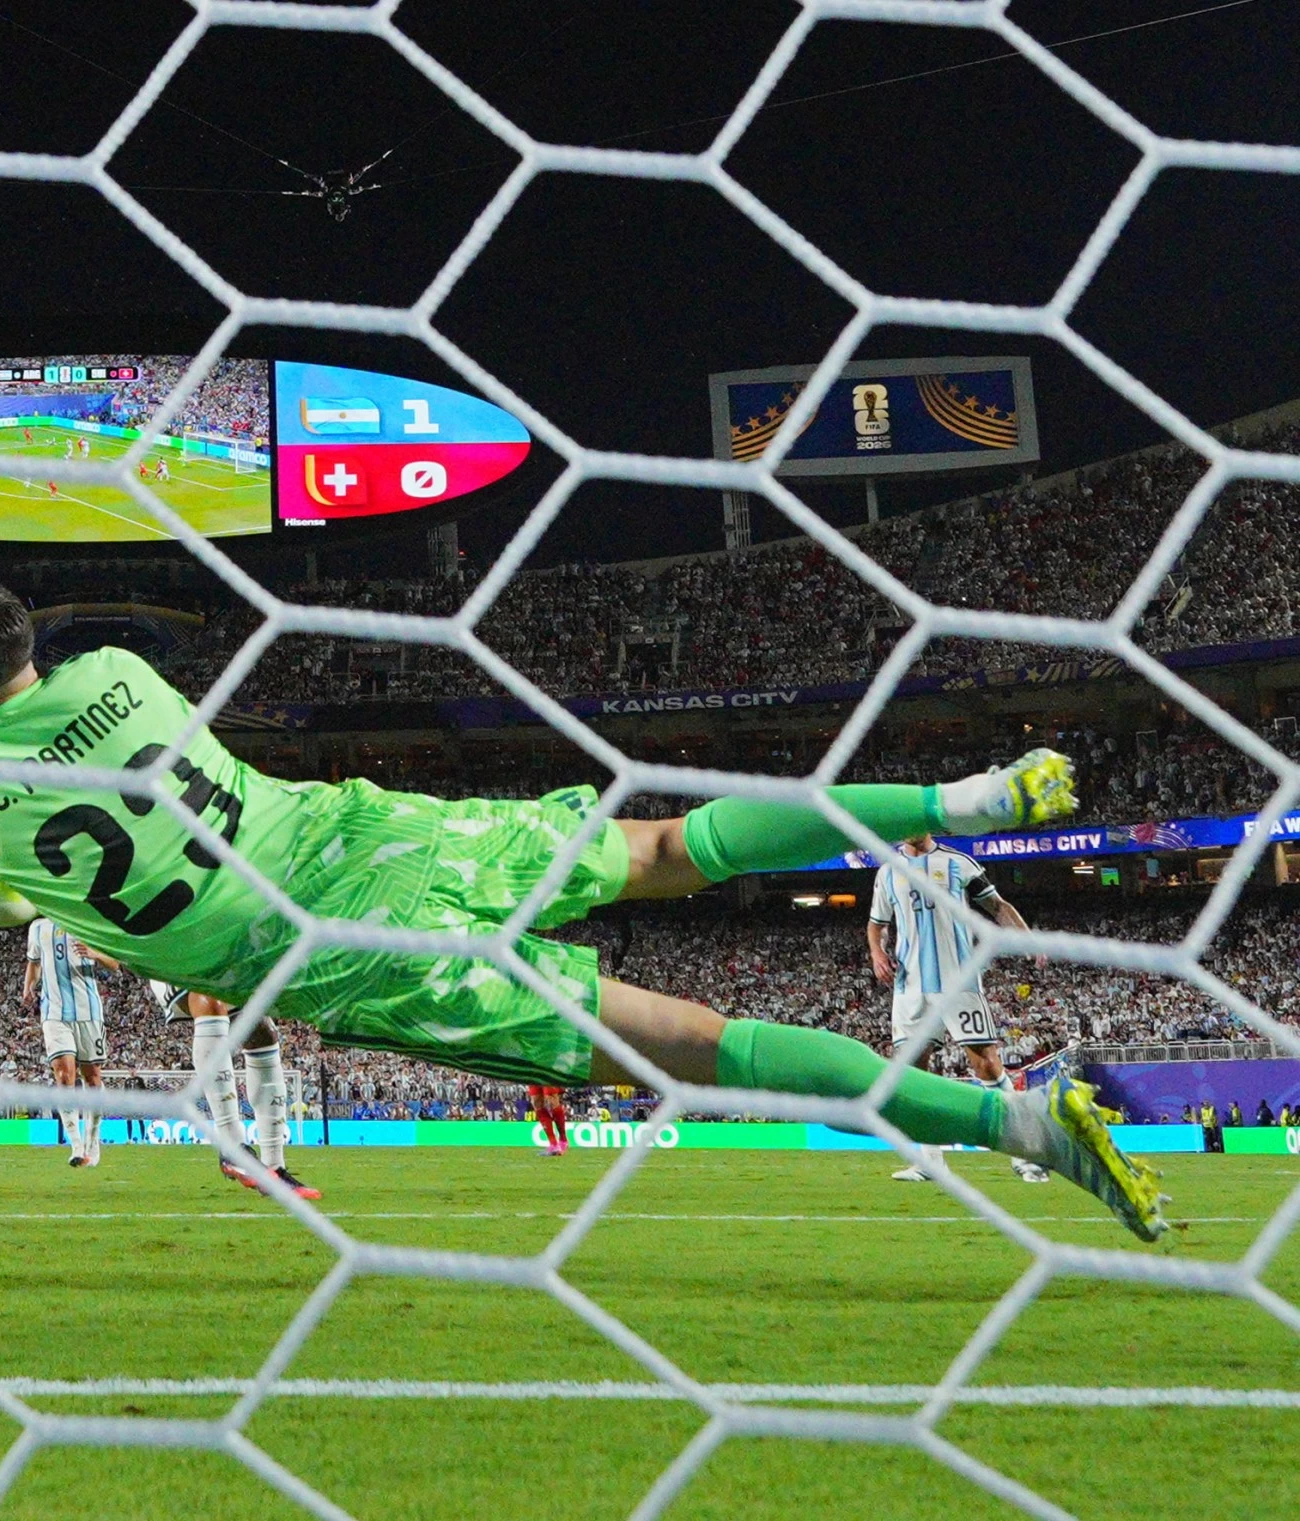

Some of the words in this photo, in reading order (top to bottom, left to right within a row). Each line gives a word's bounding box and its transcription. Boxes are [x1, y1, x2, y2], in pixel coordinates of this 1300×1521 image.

[75, 369, 83, 380] 0
[403, 399, 440, 434] 1
[865, 423, 881, 431] FIFA
[856, 441, 892, 450] 2026
[401, 461, 448, 498] 0
[284, 518, 326, 527] Hisense
[603, 695, 724, 714] KANSAS
[731, 691, 799, 708] CITY
[34, 743, 243, 935] 23
[972, 837, 1053, 856] KANSAS
[1056, 833, 1101, 851] CITY
[56, 943, 65, 961] 9
[959, 1010, 985, 1034] 20
[95, 1038, 104, 1056] 9
